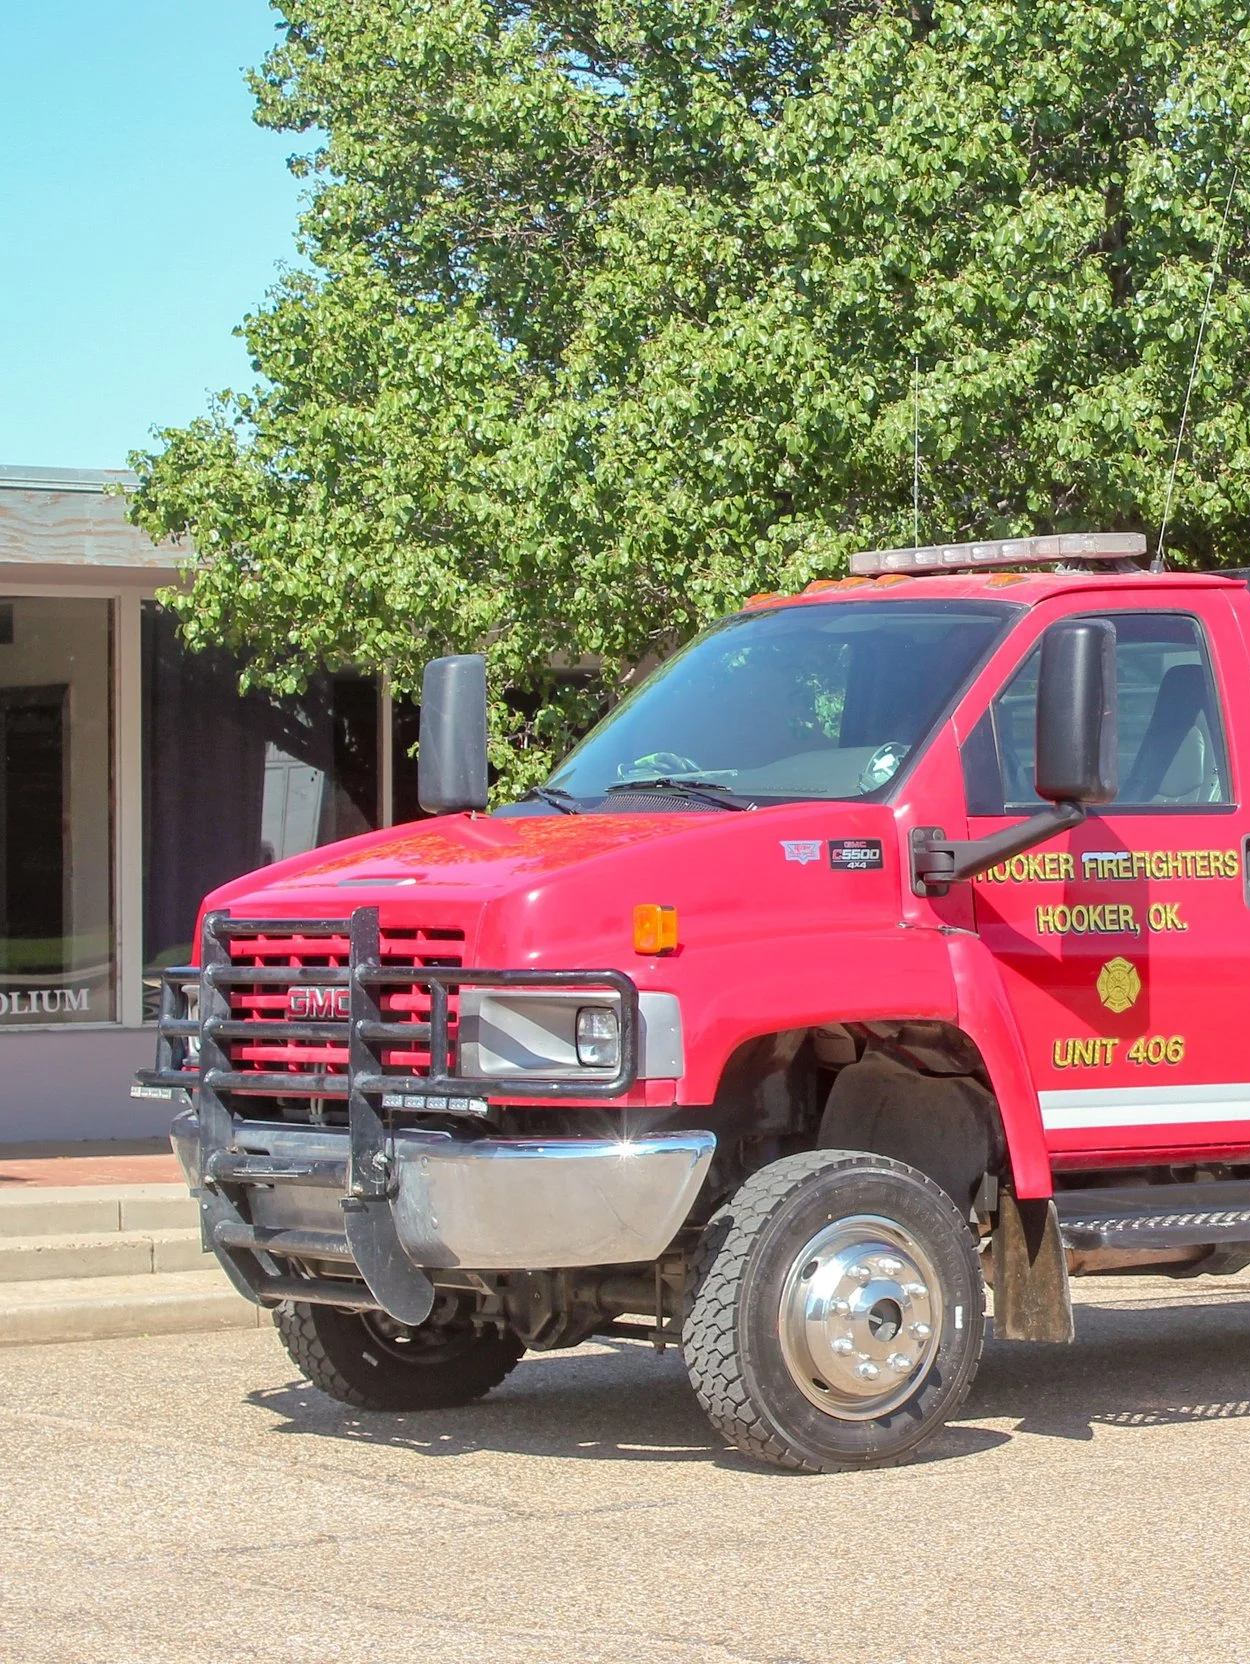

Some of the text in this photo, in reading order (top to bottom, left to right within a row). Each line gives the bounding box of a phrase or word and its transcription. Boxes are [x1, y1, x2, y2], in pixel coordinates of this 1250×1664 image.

[832, 849, 880, 860] C5500
[1081, 849, 1239, 880] FIREFIGHTERS
[1036, 903, 1188, 936] HOOKER, OK.
[1053, 1035, 1185, 1068] UNIT 406
